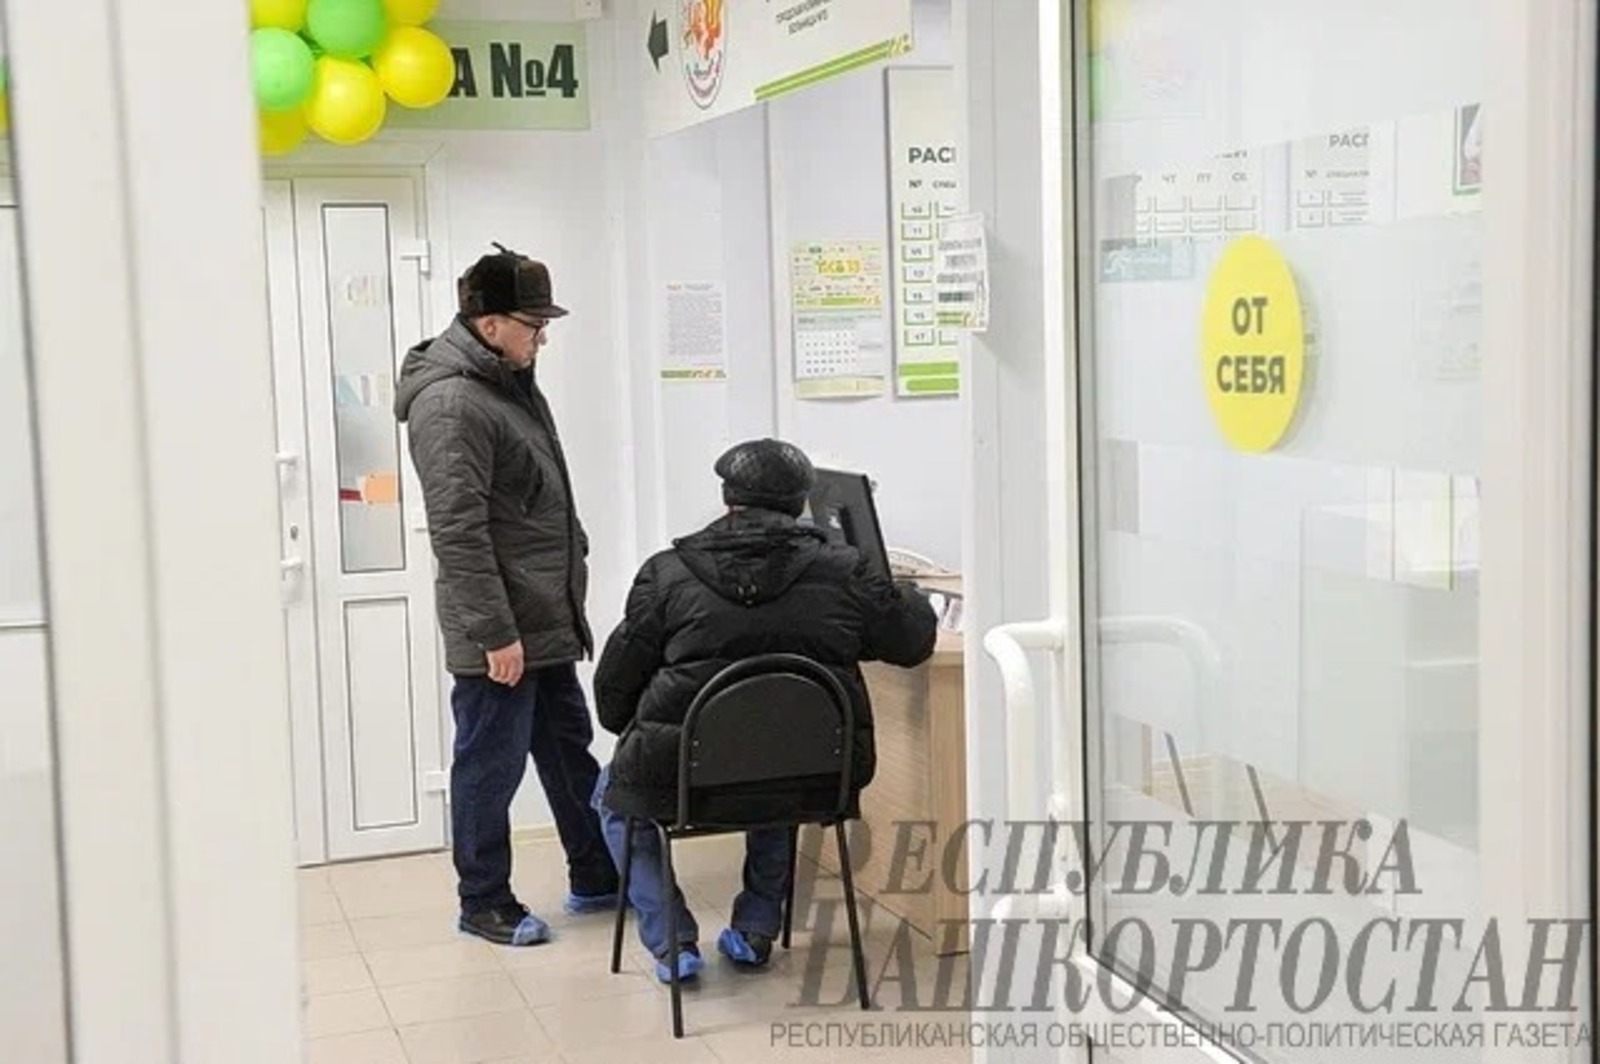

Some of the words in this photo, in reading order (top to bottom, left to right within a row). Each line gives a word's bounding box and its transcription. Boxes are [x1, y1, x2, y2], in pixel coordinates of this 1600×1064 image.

[489, 43, 579, 98] №4
[908, 146, 956, 164] РАС
[1231, 296, 1268, 336] ОТ
[1216, 354, 1286, 394] СЕБЯ
